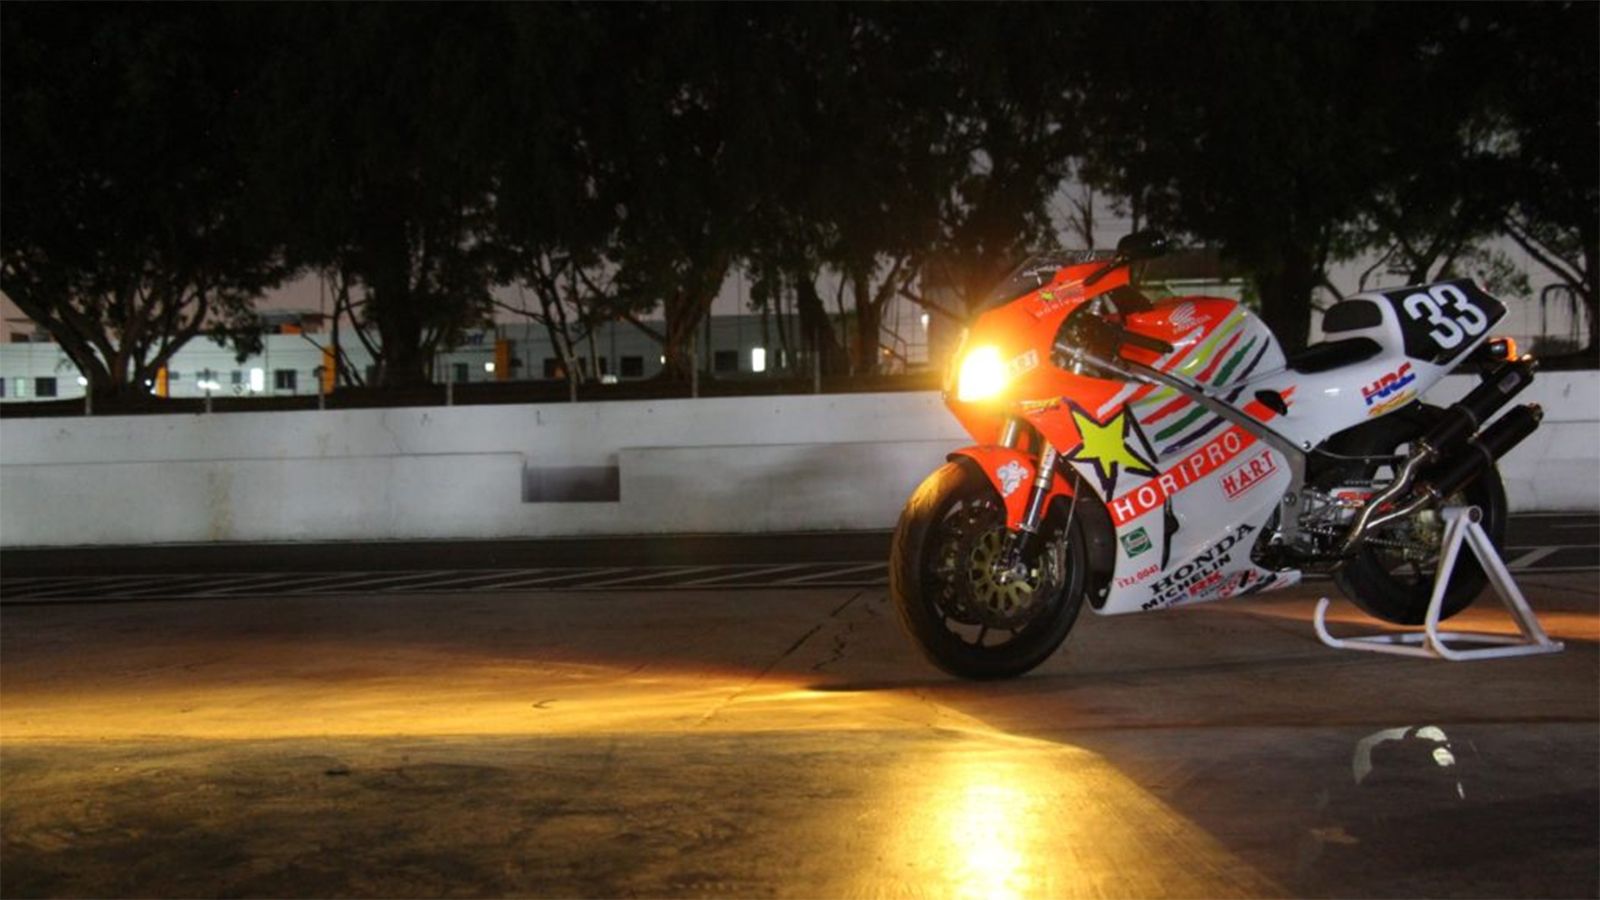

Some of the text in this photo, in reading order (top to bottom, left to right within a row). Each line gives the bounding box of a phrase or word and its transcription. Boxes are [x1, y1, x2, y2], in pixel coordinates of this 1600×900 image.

[1403, 284, 1487, 349] 33
[1361, 362, 1416, 406] HRC
[1112, 431, 1243, 522] HORIPRO
[1141, 553, 1232, 610] MICHELIN
[1149, 523, 1257, 595] HONDA
